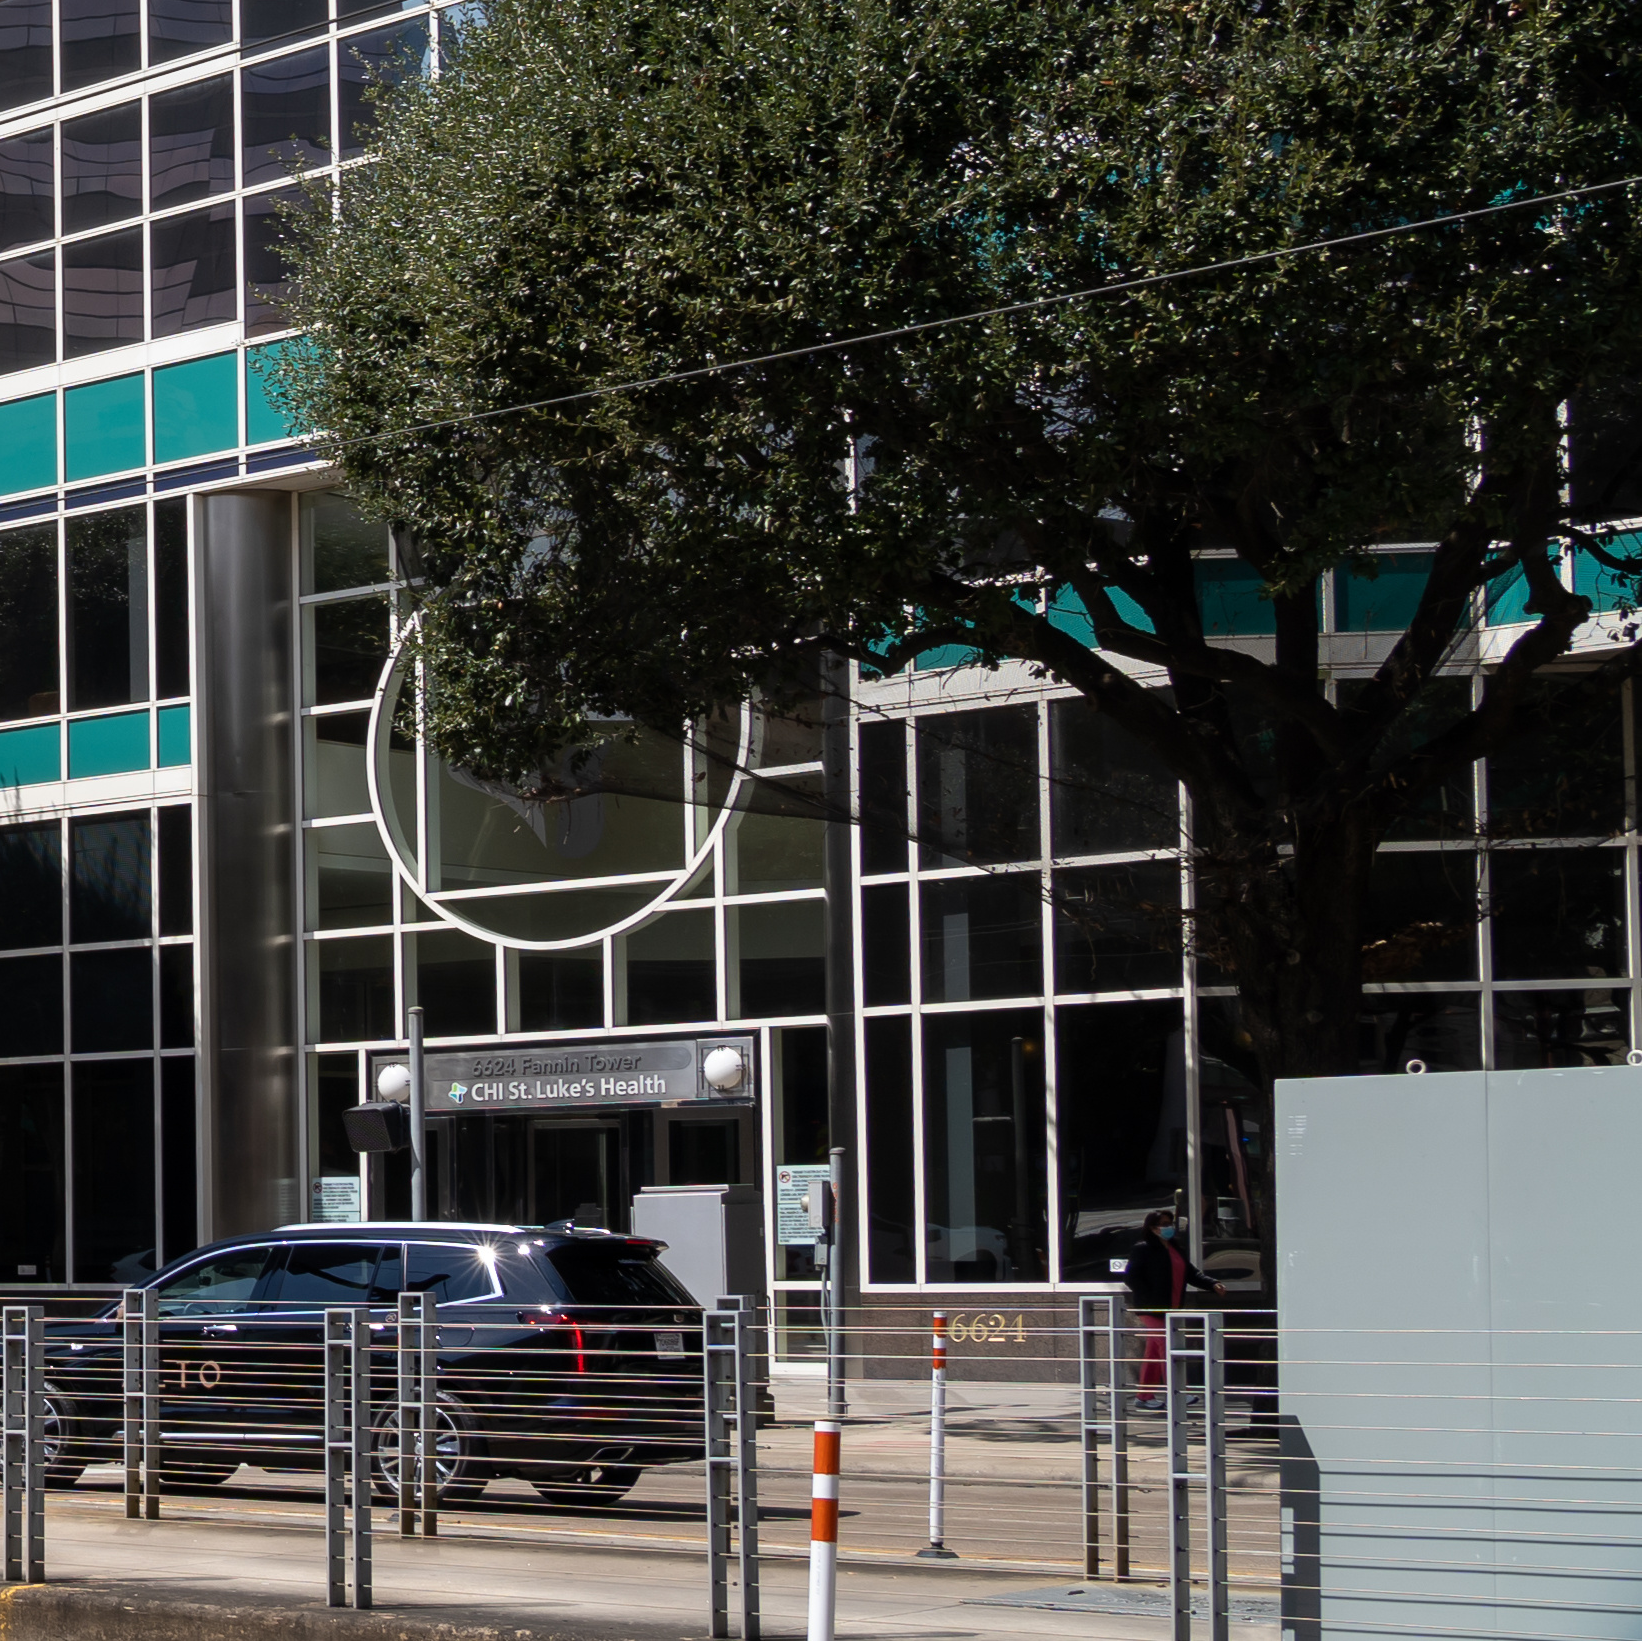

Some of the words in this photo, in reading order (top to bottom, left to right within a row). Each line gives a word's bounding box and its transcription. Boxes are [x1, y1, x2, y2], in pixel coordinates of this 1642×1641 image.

[472, 1057, 516, 1078] 6624
[522, 1055, 580, 1076] Fannin
[585, 1054, 641, 1073] Tower
[471, 1082, 504, 1101] CHI
[509, 1081, 532, 1100] St.
[536, 1078, 595, 1099] Luke's
[601, 1074, 666, 1096] Health
[949, 1313, 1026, 1343] 6624
